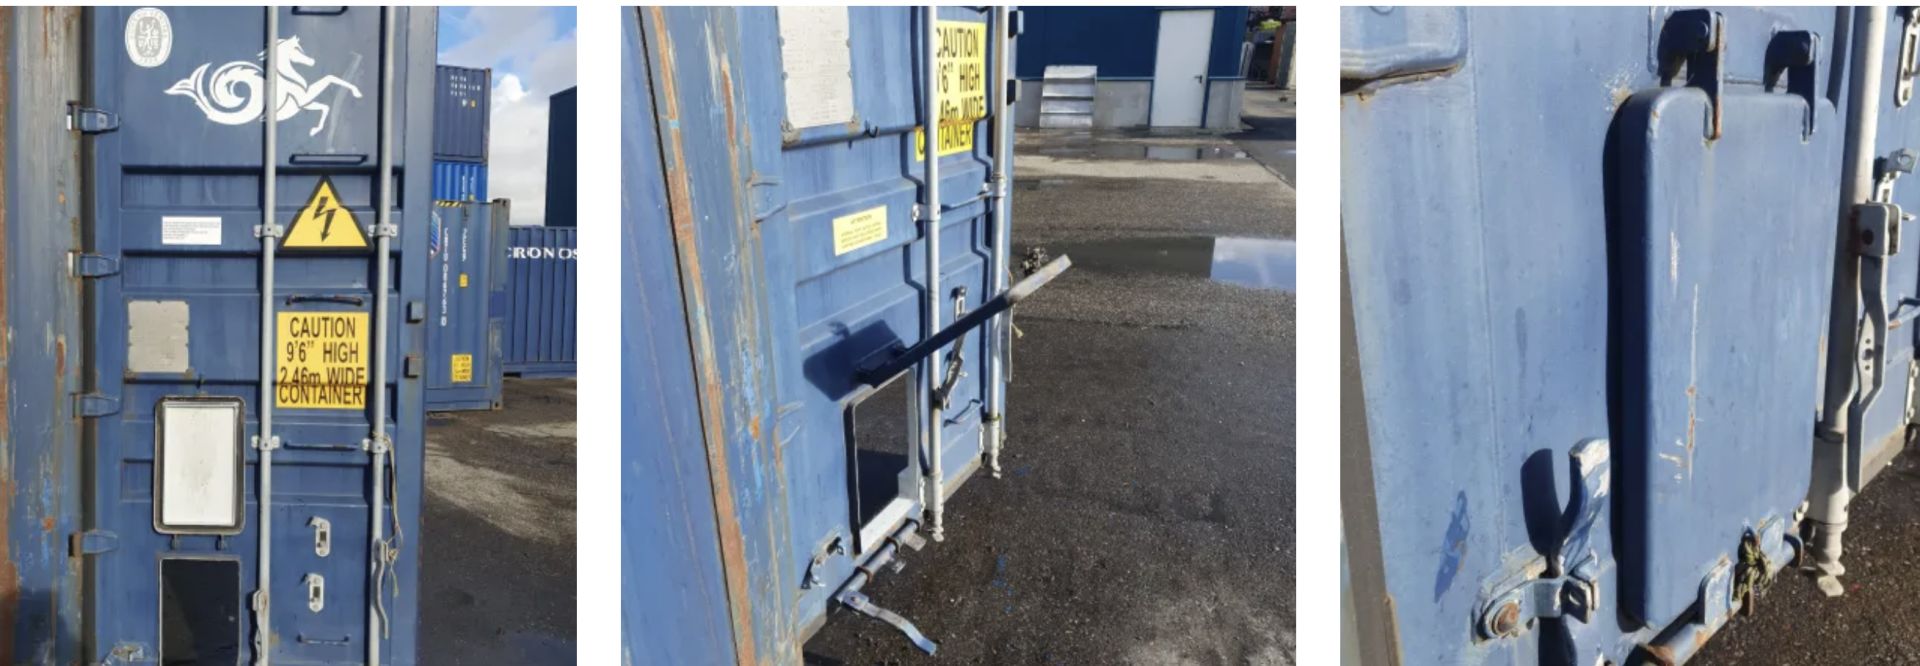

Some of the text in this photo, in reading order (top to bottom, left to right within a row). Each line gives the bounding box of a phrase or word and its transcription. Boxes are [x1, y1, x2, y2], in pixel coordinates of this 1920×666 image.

[936, 62, 980, 94] '6" HIGH
[917, 124, 972, 155] CTAINER
[289, 317, 356, 338] CAUTION
[322, 342, 359, 363] HIGH
[280, 366, 365, 386] 246m WIDE
[279, 384, 363, 405] CONTAINER
